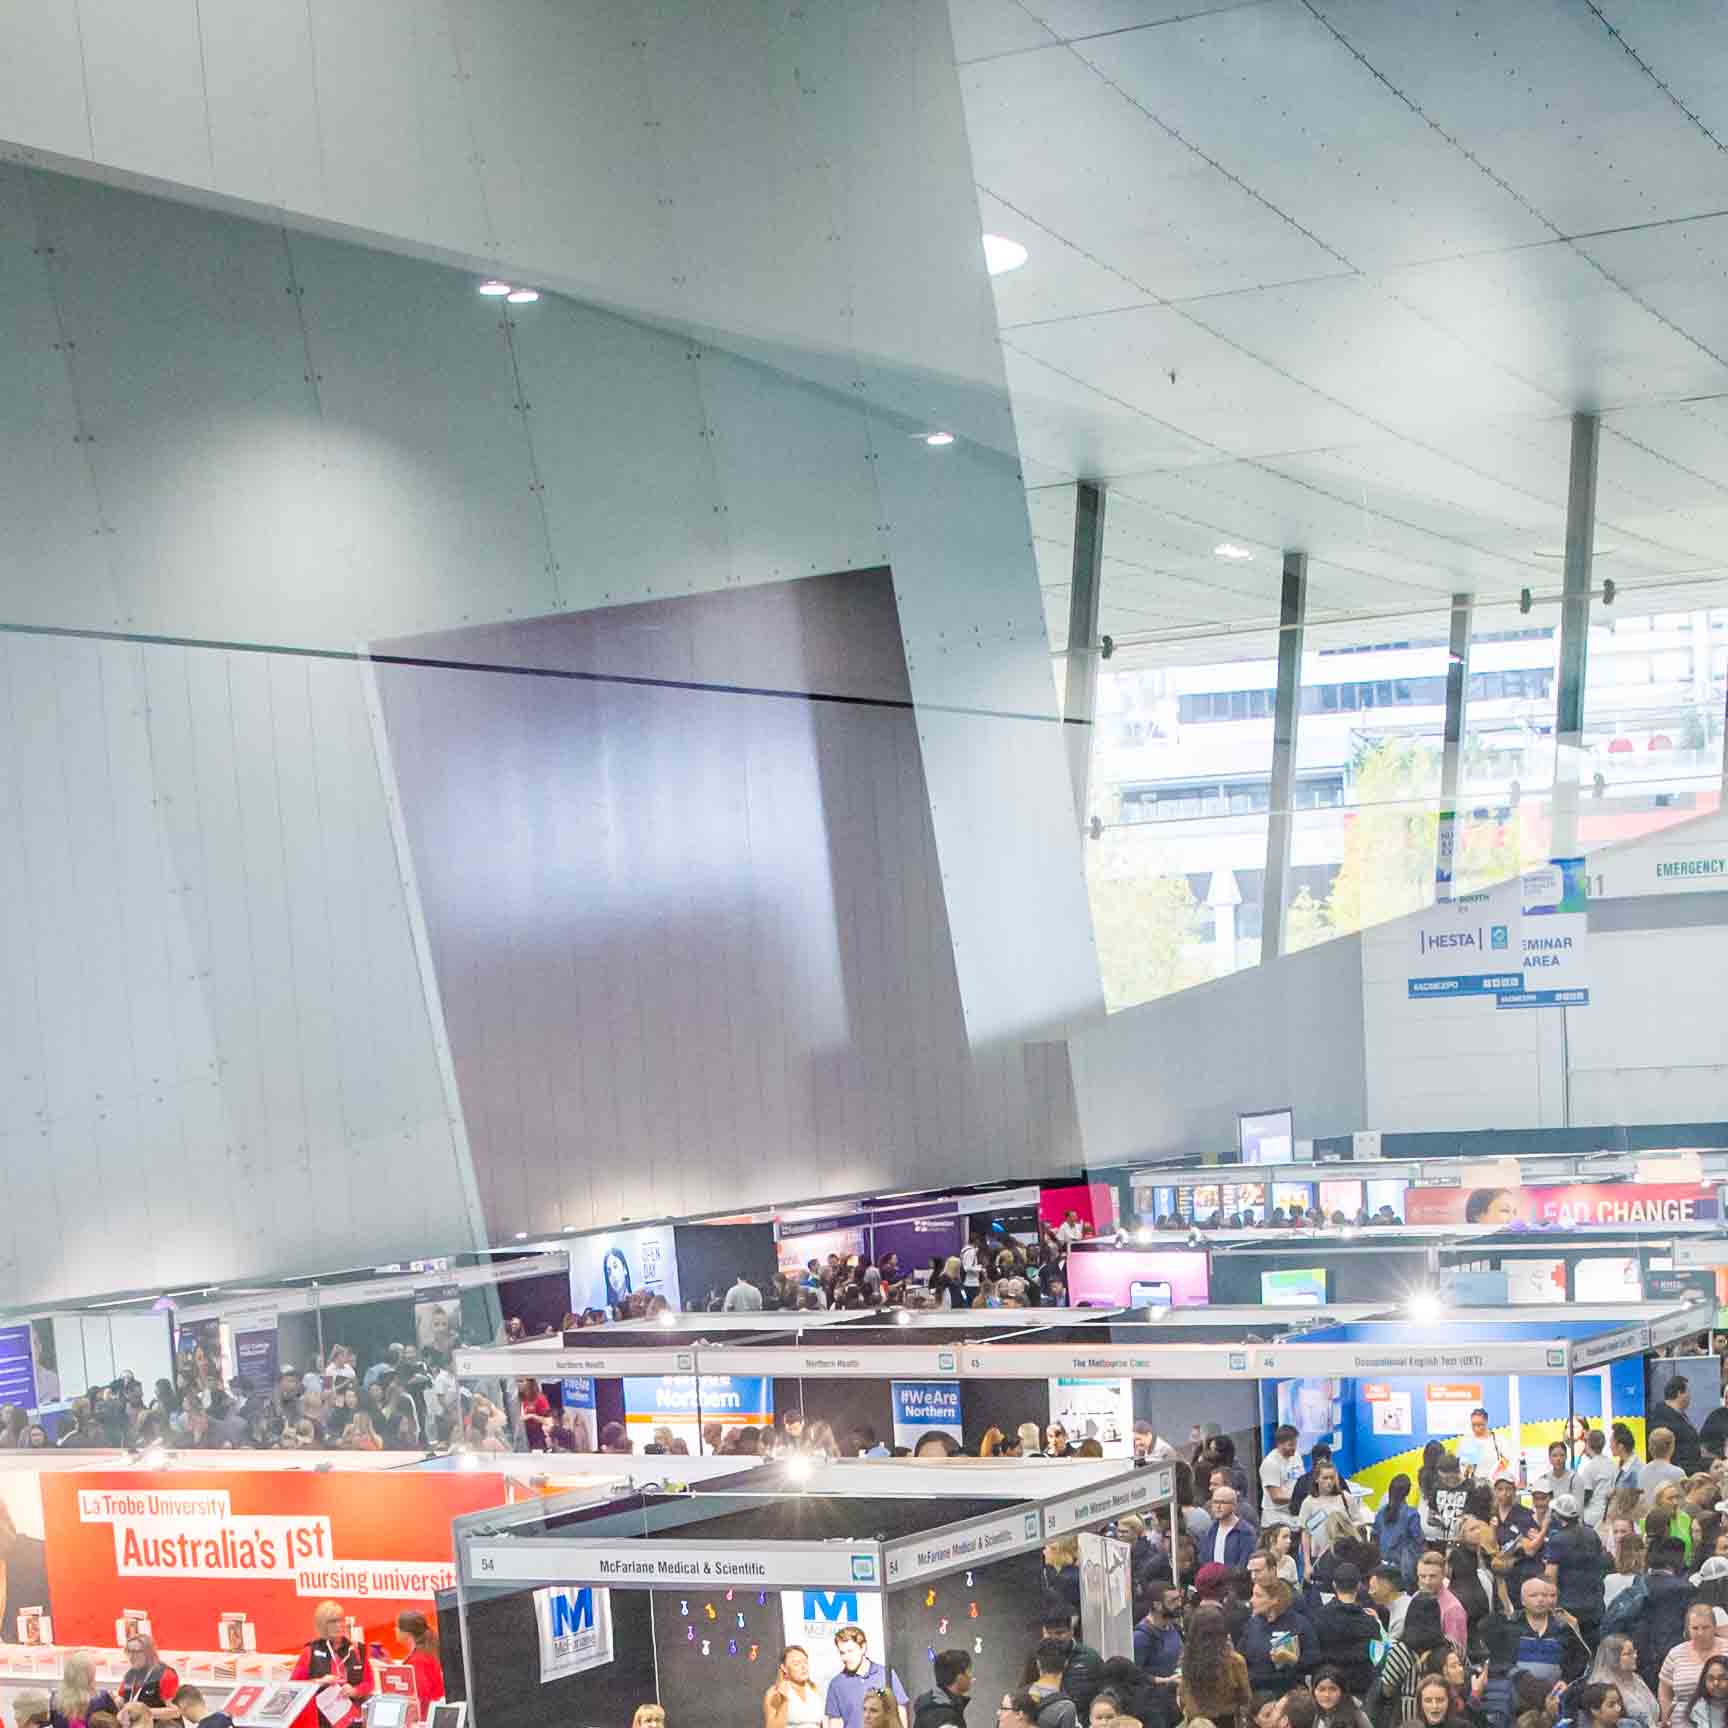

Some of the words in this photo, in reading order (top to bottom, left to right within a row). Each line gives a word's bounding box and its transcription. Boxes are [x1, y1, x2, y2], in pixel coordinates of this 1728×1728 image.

[1657, 861, 1725, 877] EMERGENCY
[1428, 934, 1476, 949] HESTA
[1522, 936, 1573, 951] EMINAR
[1523, 956, 1560, 968] AREA
[1597, 1200, 1696, 1222] CHANGE
[1073, 1359, 1086, 1368] The
[1088, 1359, 1127, 1368] Melbourne
[1409, 1356, 1438, 1369] English
[656, 1388, 740, 1409] Northern
[900, 1389, 958, 1405] #WeAre
[904, 1405, 956, 1419] Northern
[83, 1497, 101, 1515] La
[103, 1495, 145, 1515] Trobe
[148, 1495, 226, 1520] University
[122, 1527, 276, 1570] Australia's
[287, 1522, 326, 1569] 1st
[917, 1548, 951, 1567] McFarlane
[952, 1541, 977, 1558] Medical
[481, 1558, 494, 1572] 54
[599, 1560, 655, 1574] McFarlane
[658, 1560, 700, 1575] Medical
[703, 1562, 712, 1574] &
[715, 1561, 766, 1576] Scientific
[889, 1561, 899, 1575] 54
[299, 1569, 368, 1594] nursing
